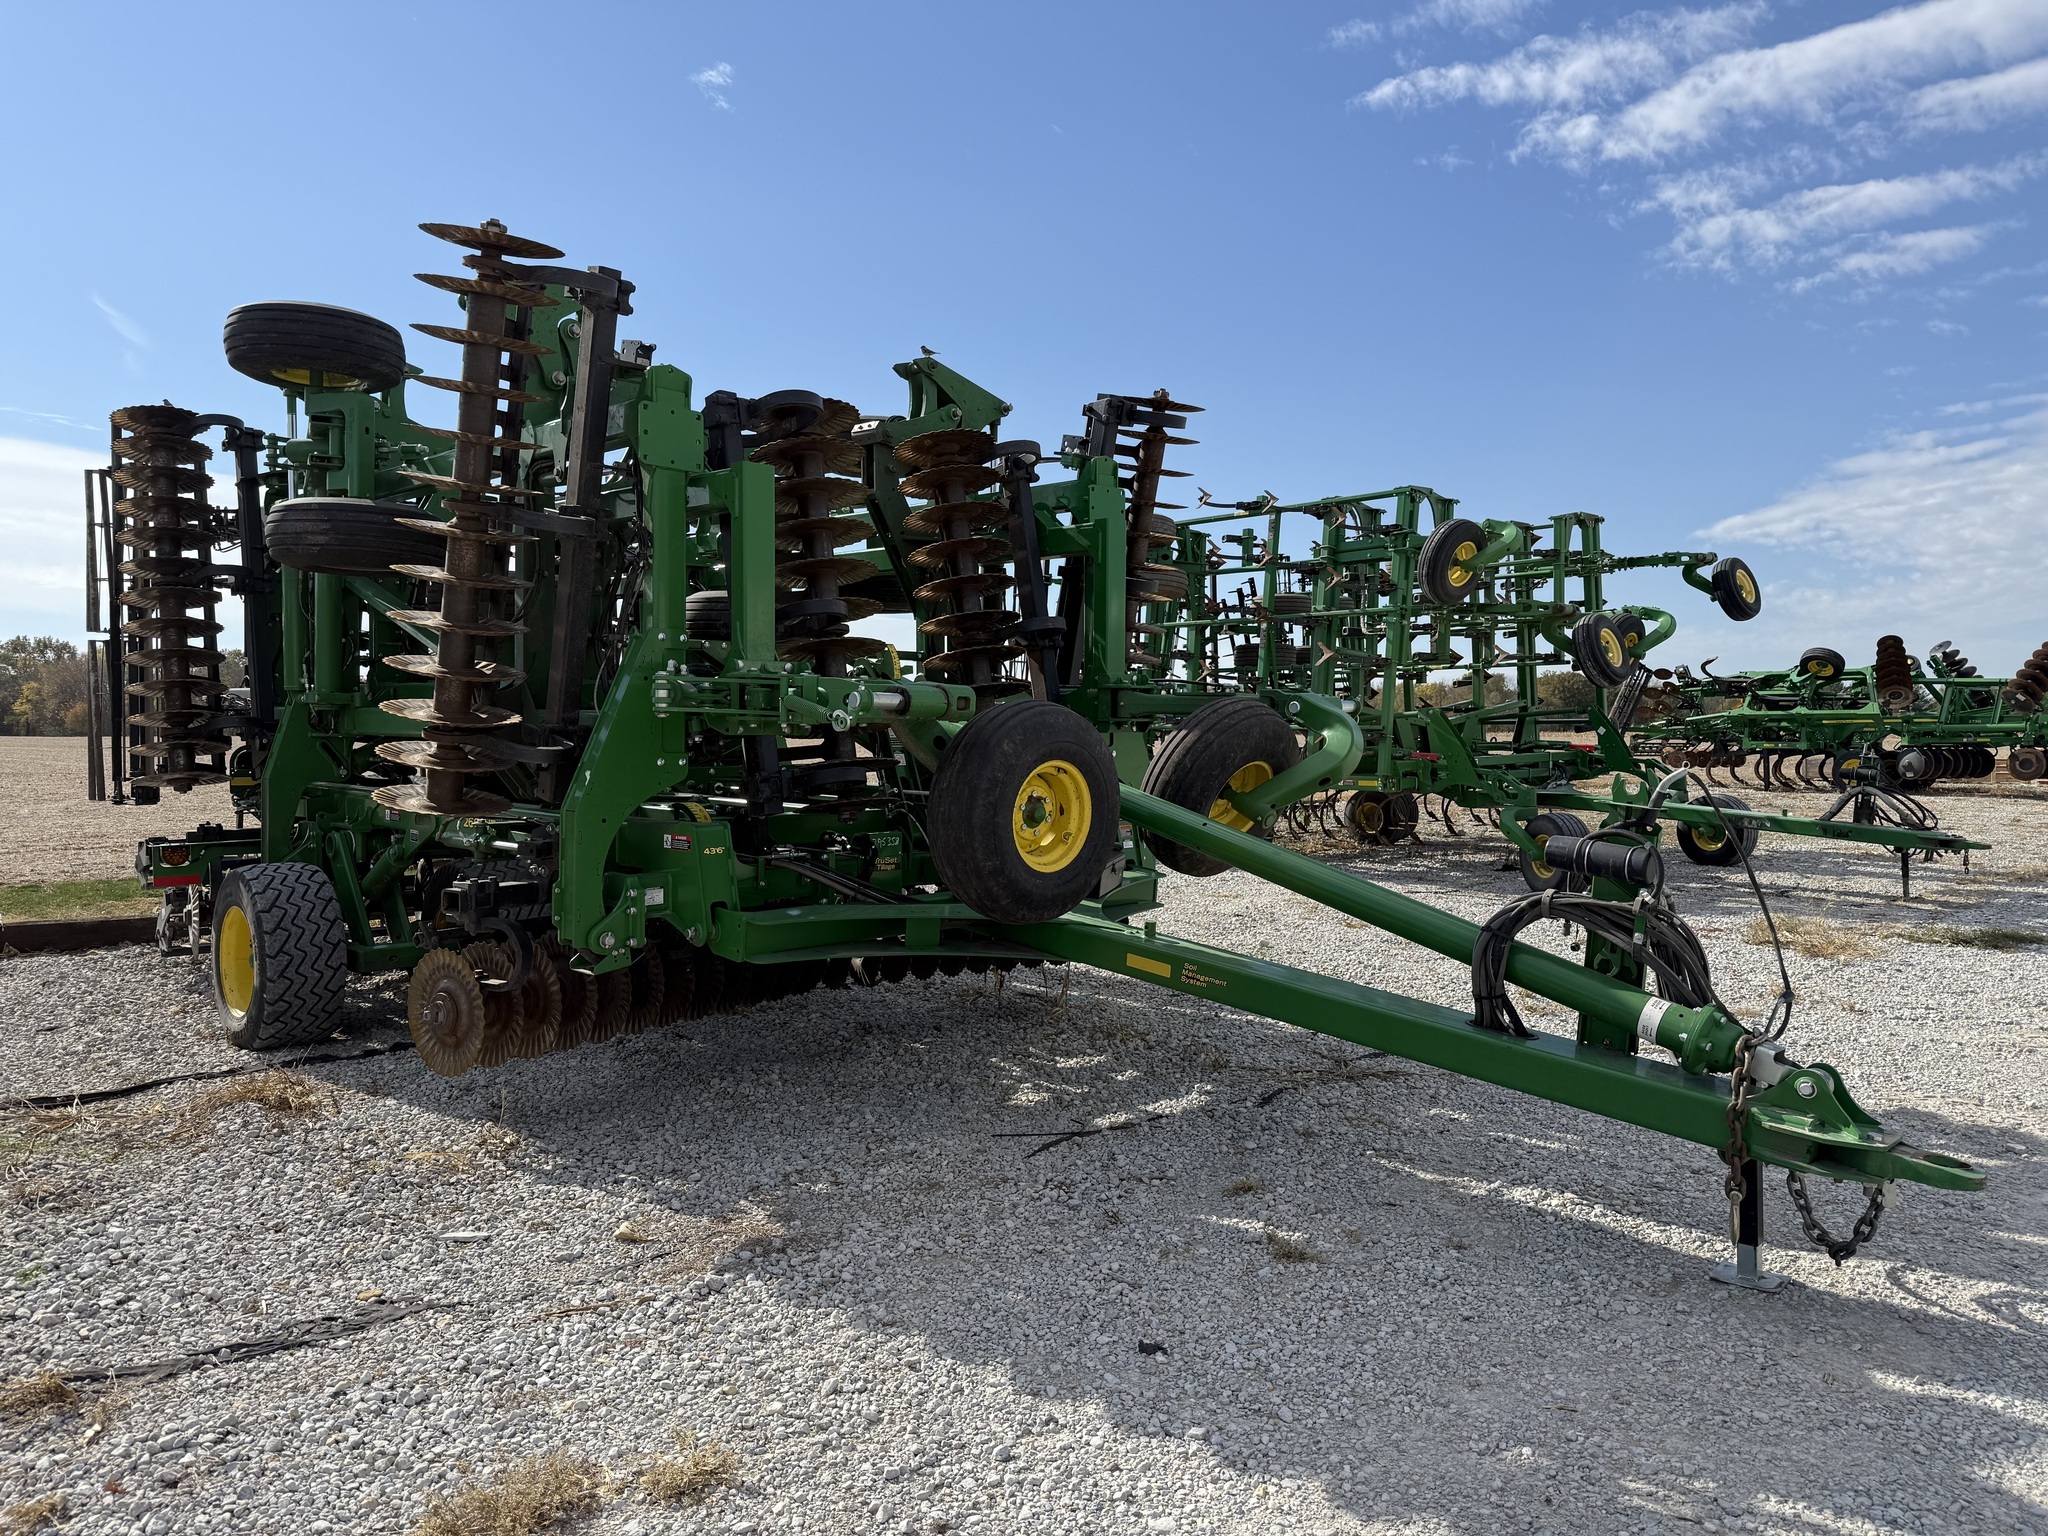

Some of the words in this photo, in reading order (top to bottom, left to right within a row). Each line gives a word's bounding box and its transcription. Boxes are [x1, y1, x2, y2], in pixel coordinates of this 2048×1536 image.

[1183, 962, 1198, 972] Soil
[1180, 975, 1207, 988] System
[1181, 969, 1228, 987] Management
